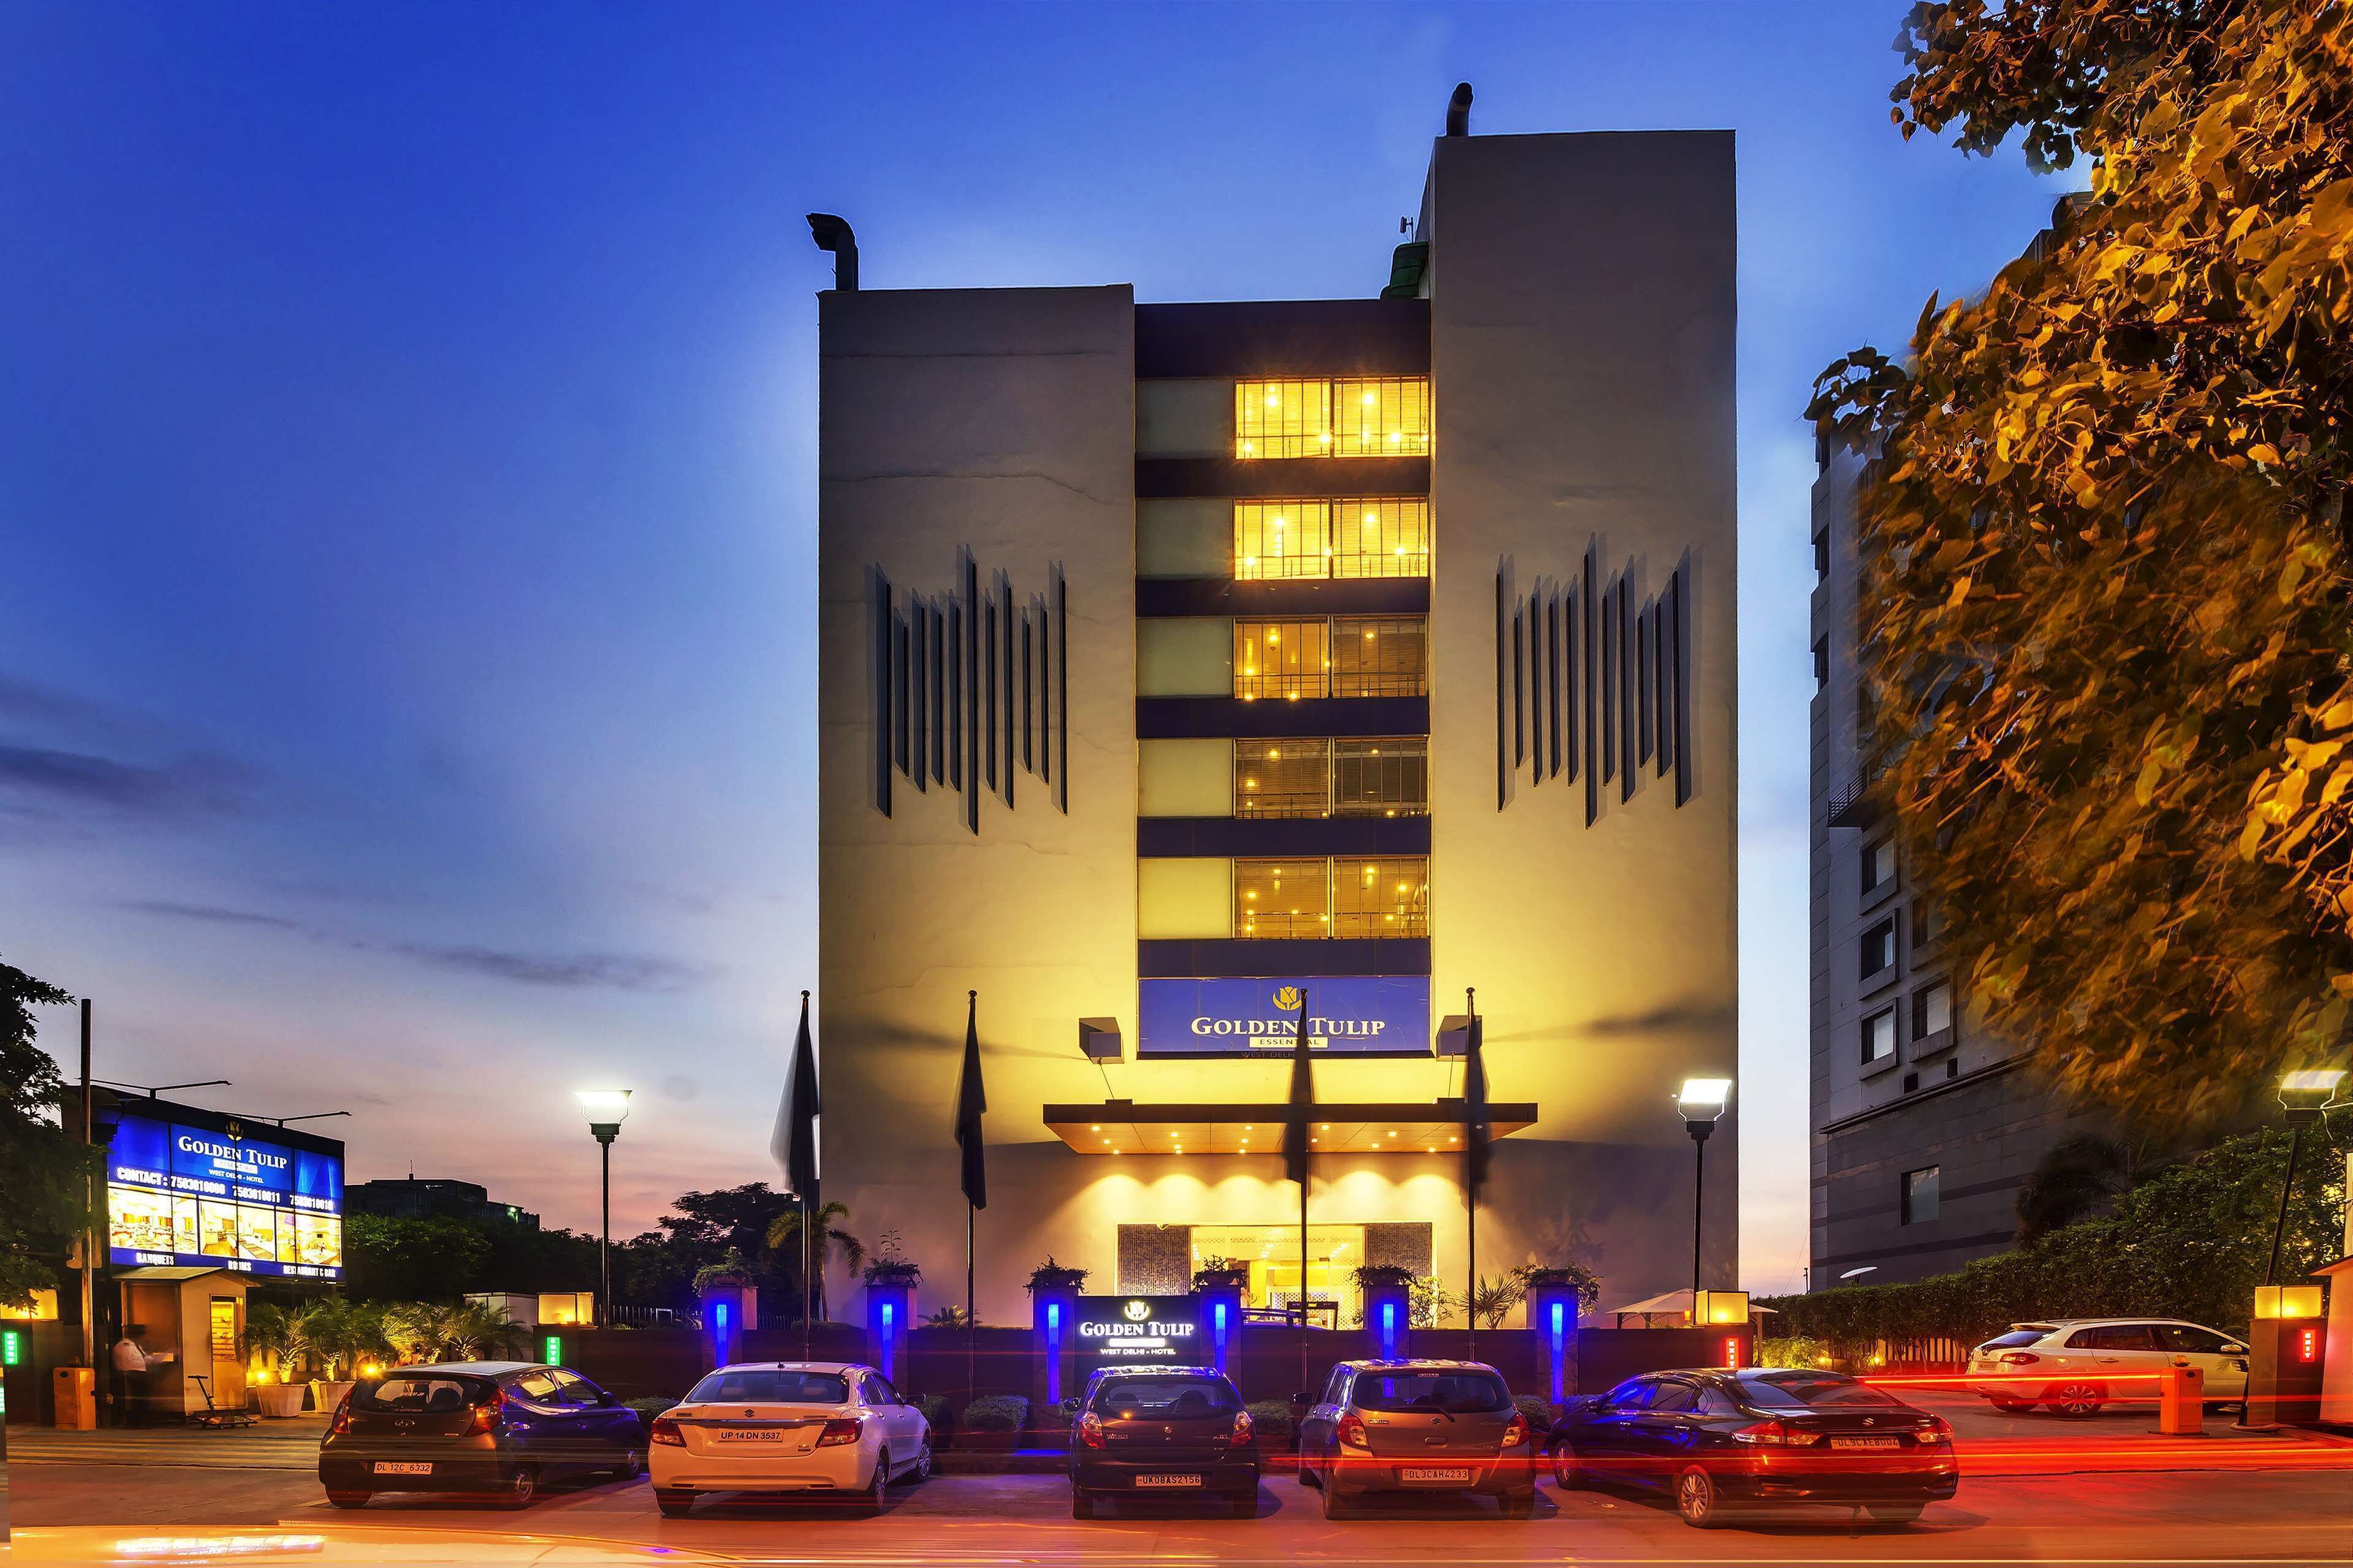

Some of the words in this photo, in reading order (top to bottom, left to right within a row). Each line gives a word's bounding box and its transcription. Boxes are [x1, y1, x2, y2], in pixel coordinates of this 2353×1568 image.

[1191, 1017, 1298, 1035] GOLDEN
[1309, 1017, 1386, 1035] TULIP
[178, 1135, 241, 1161] GOLDEN
[246, 1149, 287, 1170] TULIP
[246, 1175, 264, 1184] HOTEL
[1079, 1321, 1144, 1336] GOLDEN
[1147, 1321, 1195, 1336] TULIP
[760, 1431, 781, 1440] 3537
